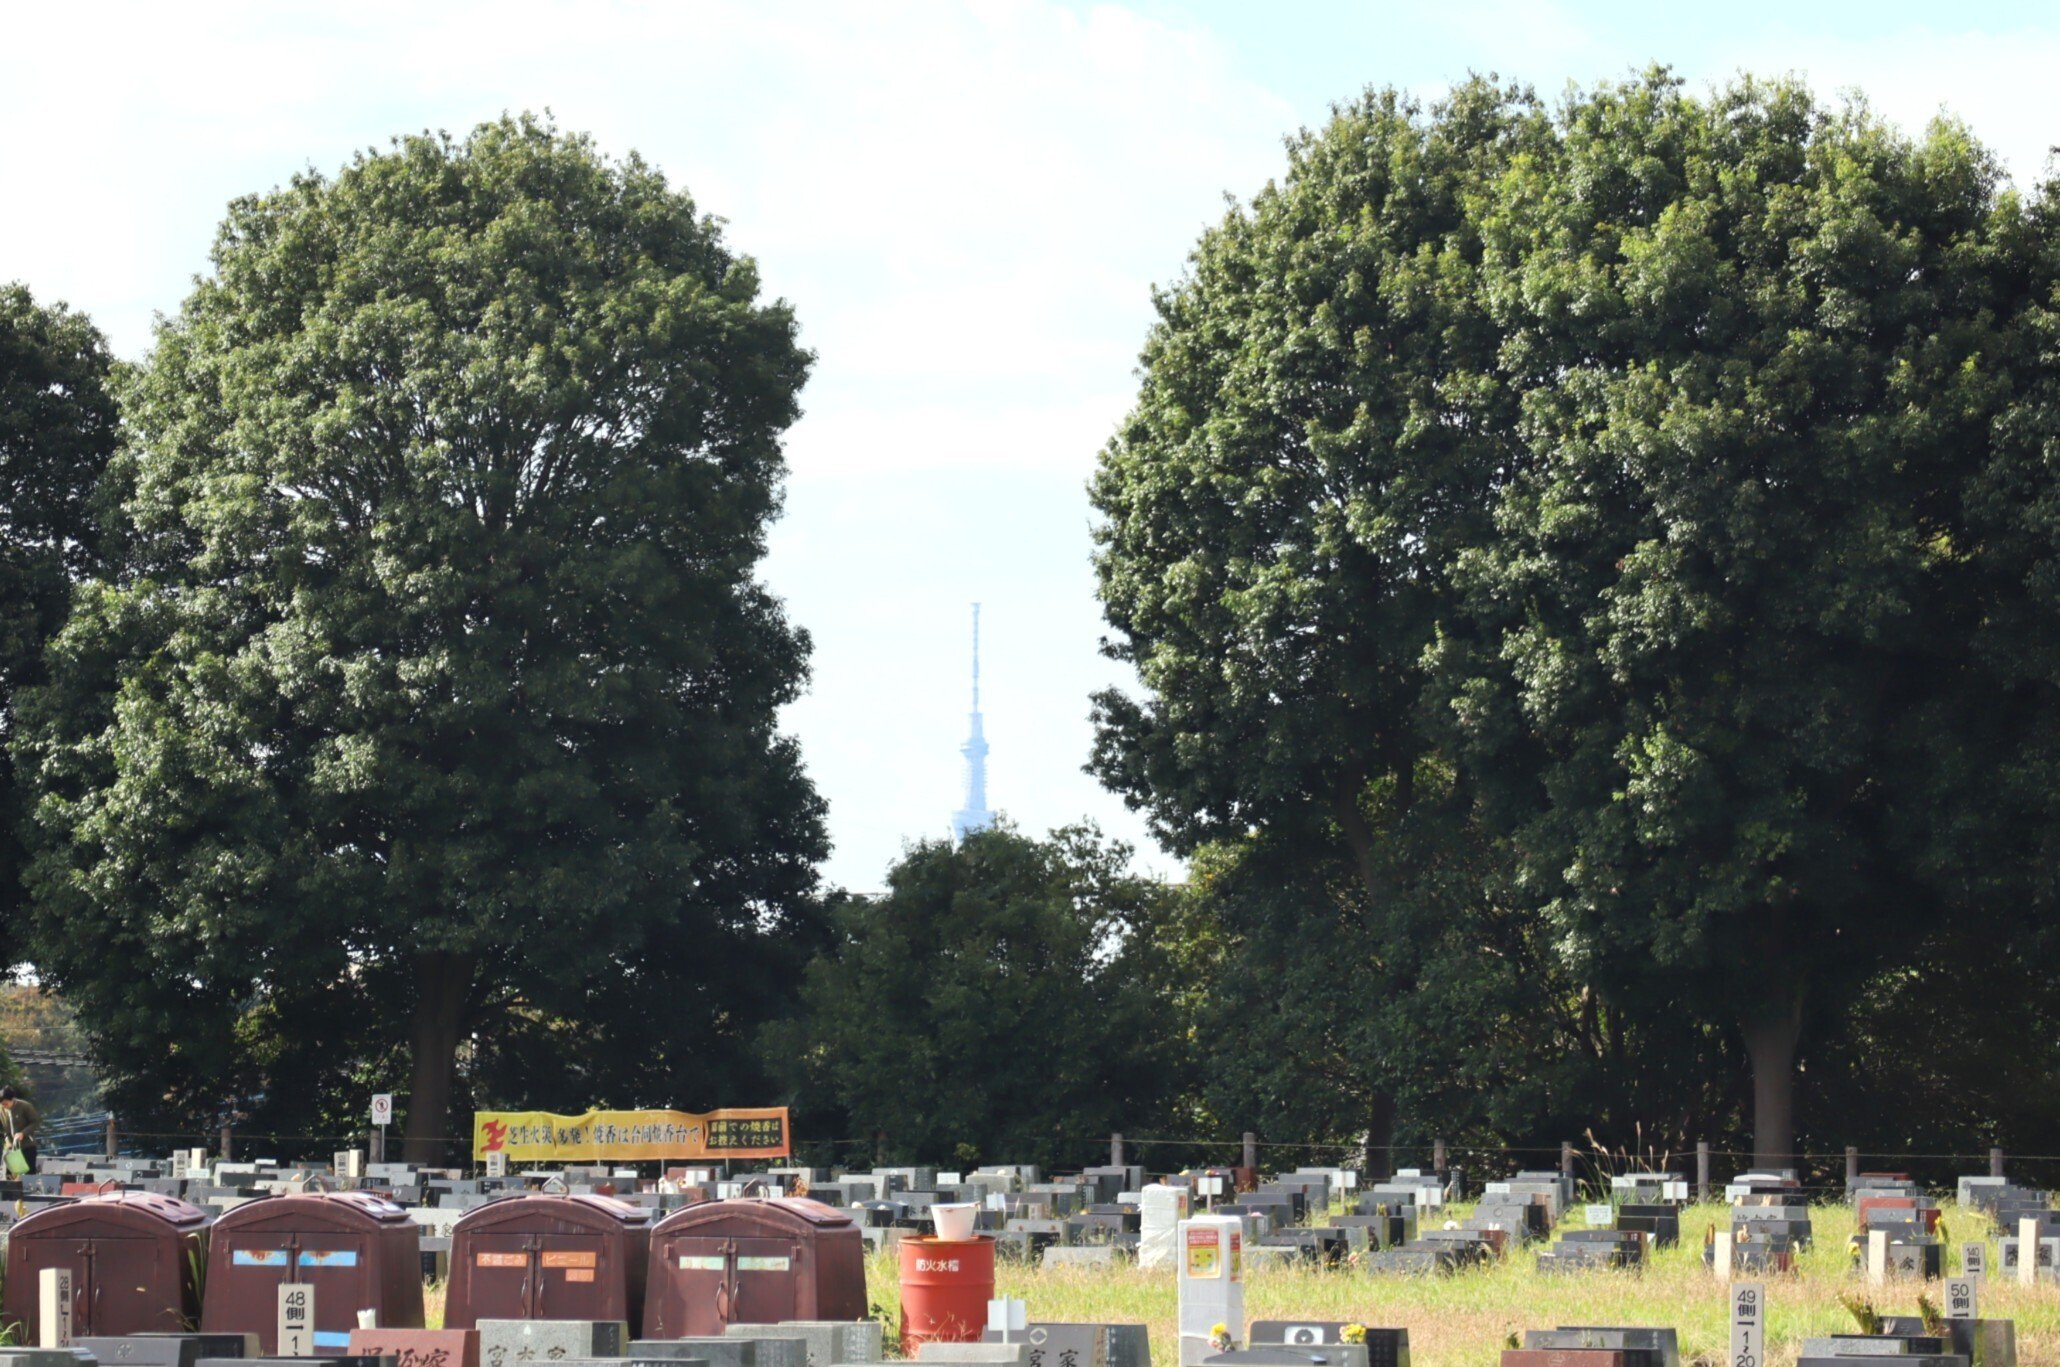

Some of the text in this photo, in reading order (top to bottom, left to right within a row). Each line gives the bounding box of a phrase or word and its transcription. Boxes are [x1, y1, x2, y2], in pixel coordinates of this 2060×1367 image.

[286, 1291, 305, 1320] 48側
[1737, 1290, 1756, 1316] 49側
[1951, 1284, 1969, 1309] 50側
